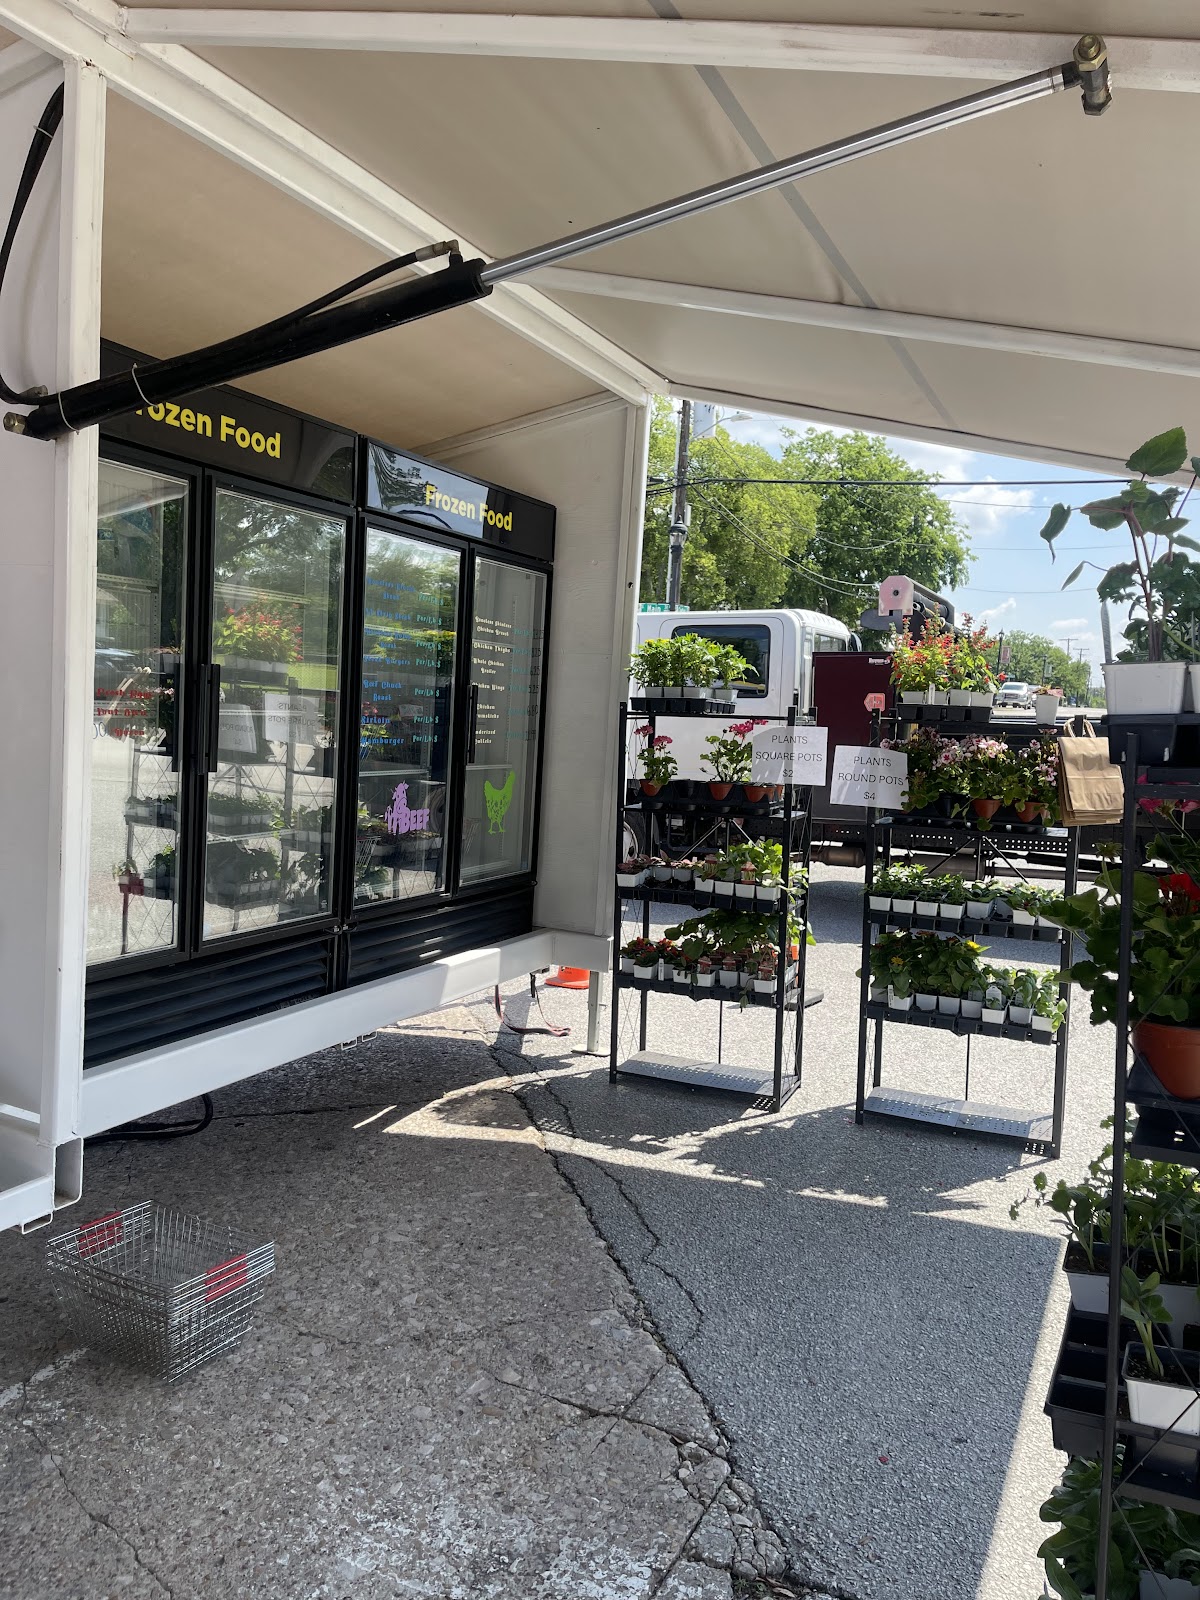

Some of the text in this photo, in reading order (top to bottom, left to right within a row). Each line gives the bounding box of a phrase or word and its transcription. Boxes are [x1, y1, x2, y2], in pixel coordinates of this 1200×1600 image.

[135, 402, 281, 459] ozen Food
[425, 484, 513, 532] Frozen Food
[476, 626, 495, 634] Chicken
[473, 642, 511, 654] Chicken Thighs
[363, 679, 402, 689] Beef Chuck
[491, 684, 505, 692] Wings
[373, 693, 392, 701] Roast
[361, 715, 391, 724] Sirloin
[360, 736, 405, 746] Hamburger
[771, 734, 808, 745] PLANTS
[755, 751, 823, 762] SQUARE POTS
[853, 756, 892, 768] PLANTS
[782, 768, 794, 778] $2
[837, 772, 904, 786] ROUND POTS
[863, 791, 876, 801] $4
[399, 807, 430, 834] BEEF
